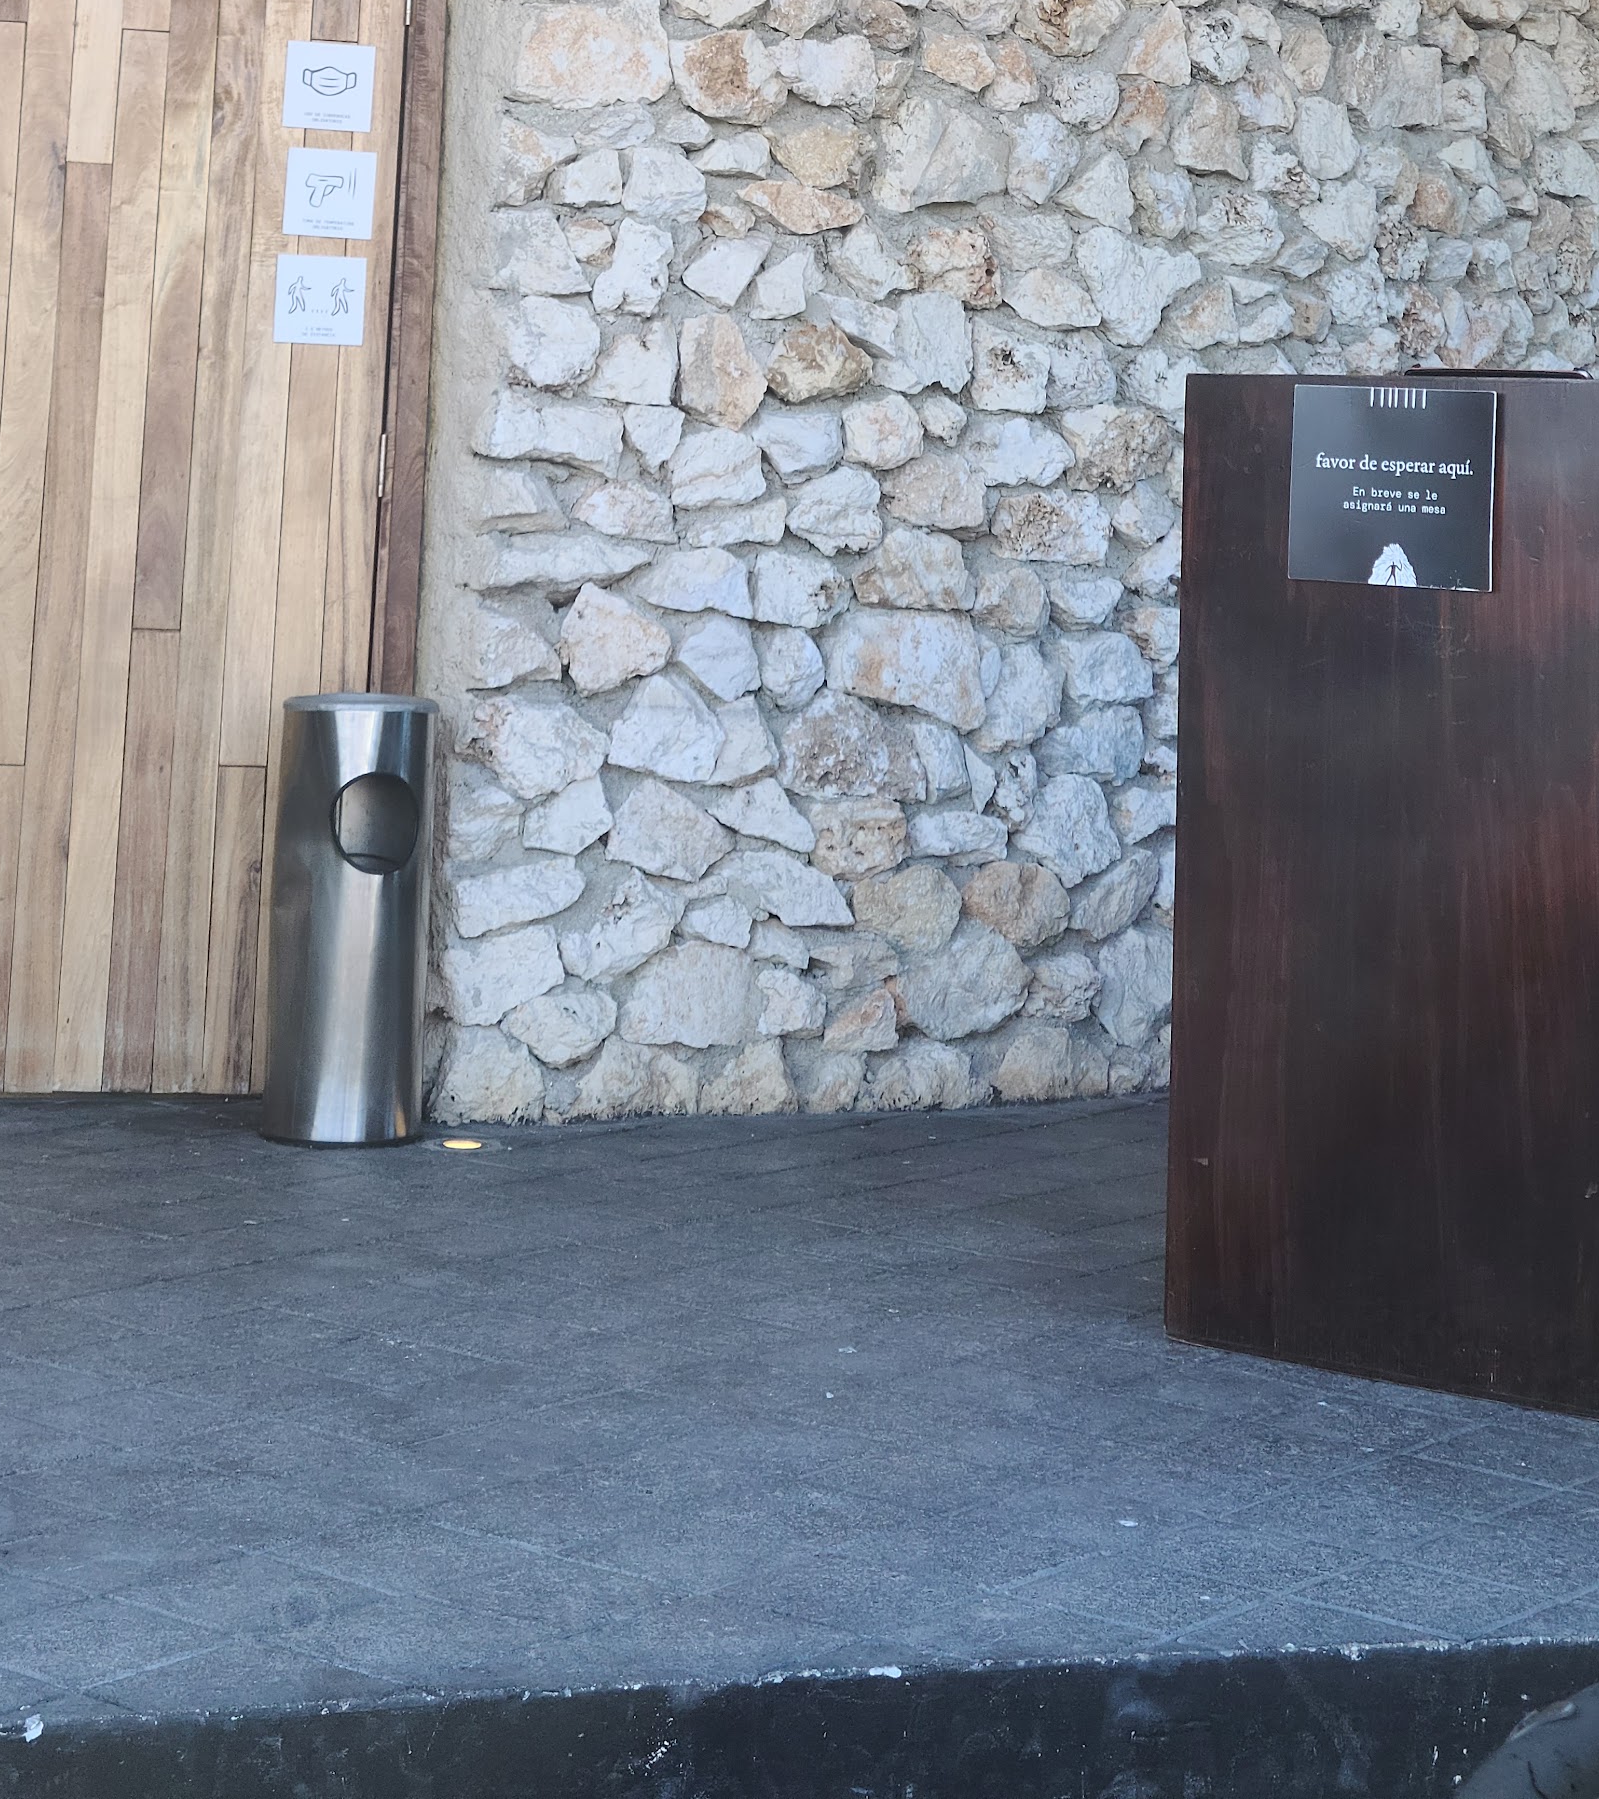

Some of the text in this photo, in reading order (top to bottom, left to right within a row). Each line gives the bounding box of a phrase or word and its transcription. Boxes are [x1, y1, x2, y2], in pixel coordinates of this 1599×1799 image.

[1315, 452, 1474, 479] favor de esperar aquí.
[1352, 486, 1438, 501] En breve se le
[1343, 500, 1446, 515] asignará una mesa
